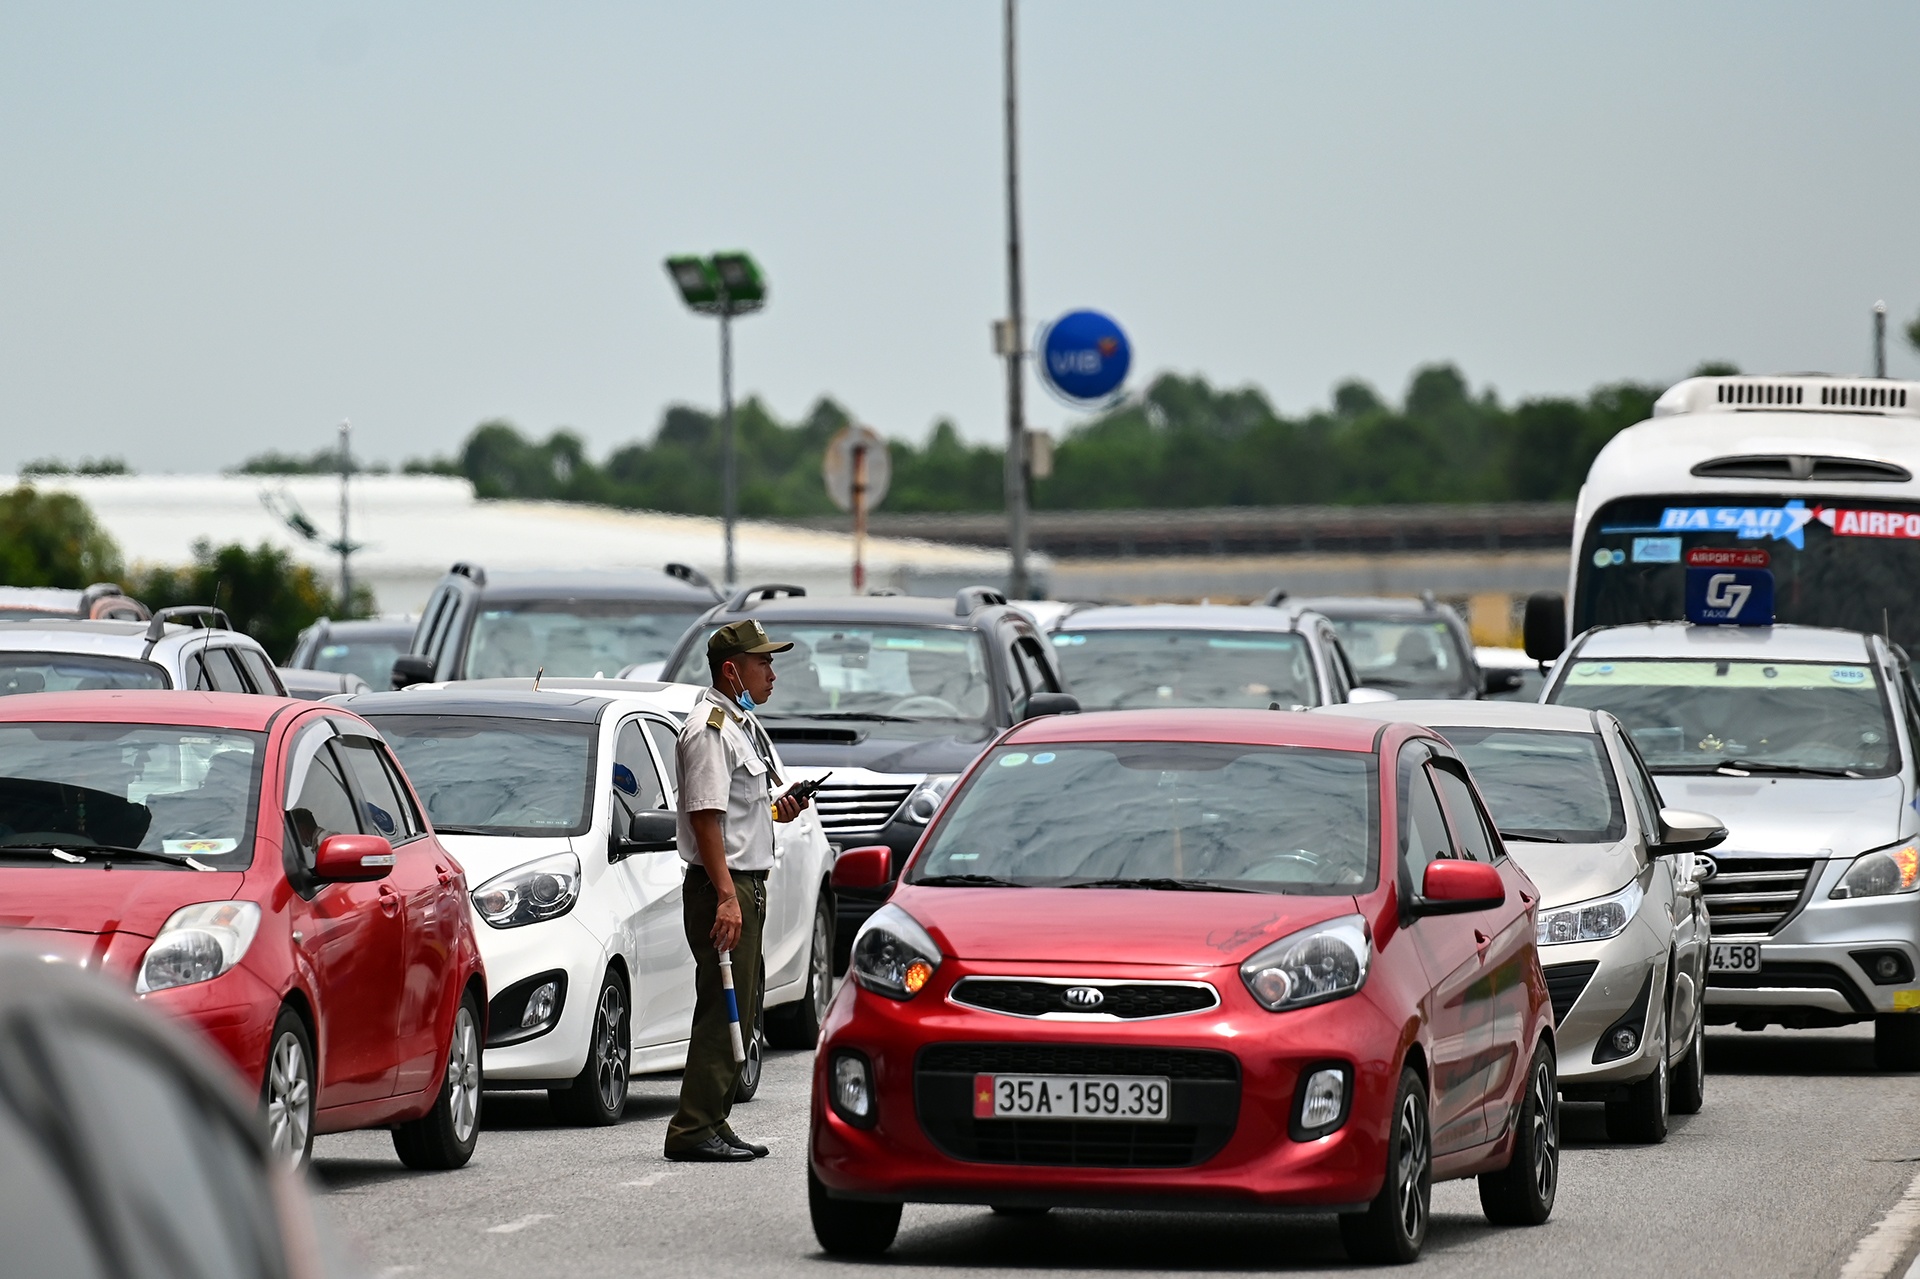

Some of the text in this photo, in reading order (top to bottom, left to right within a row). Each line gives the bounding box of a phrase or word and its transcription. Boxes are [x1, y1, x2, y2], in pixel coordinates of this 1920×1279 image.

[1050, 349, 1102, 375] VIB
[1664, 508, 1783, 529] BA SAO
[1839, 511, 1920, 537] AIRPO
[1706, 573, 1752, 618] G7
[1708, 945, 1757, 969] 4.58
[1066, 989, 1097, 1004] KIA
[998, 1080, 1164, 1115] 35A-159.39
